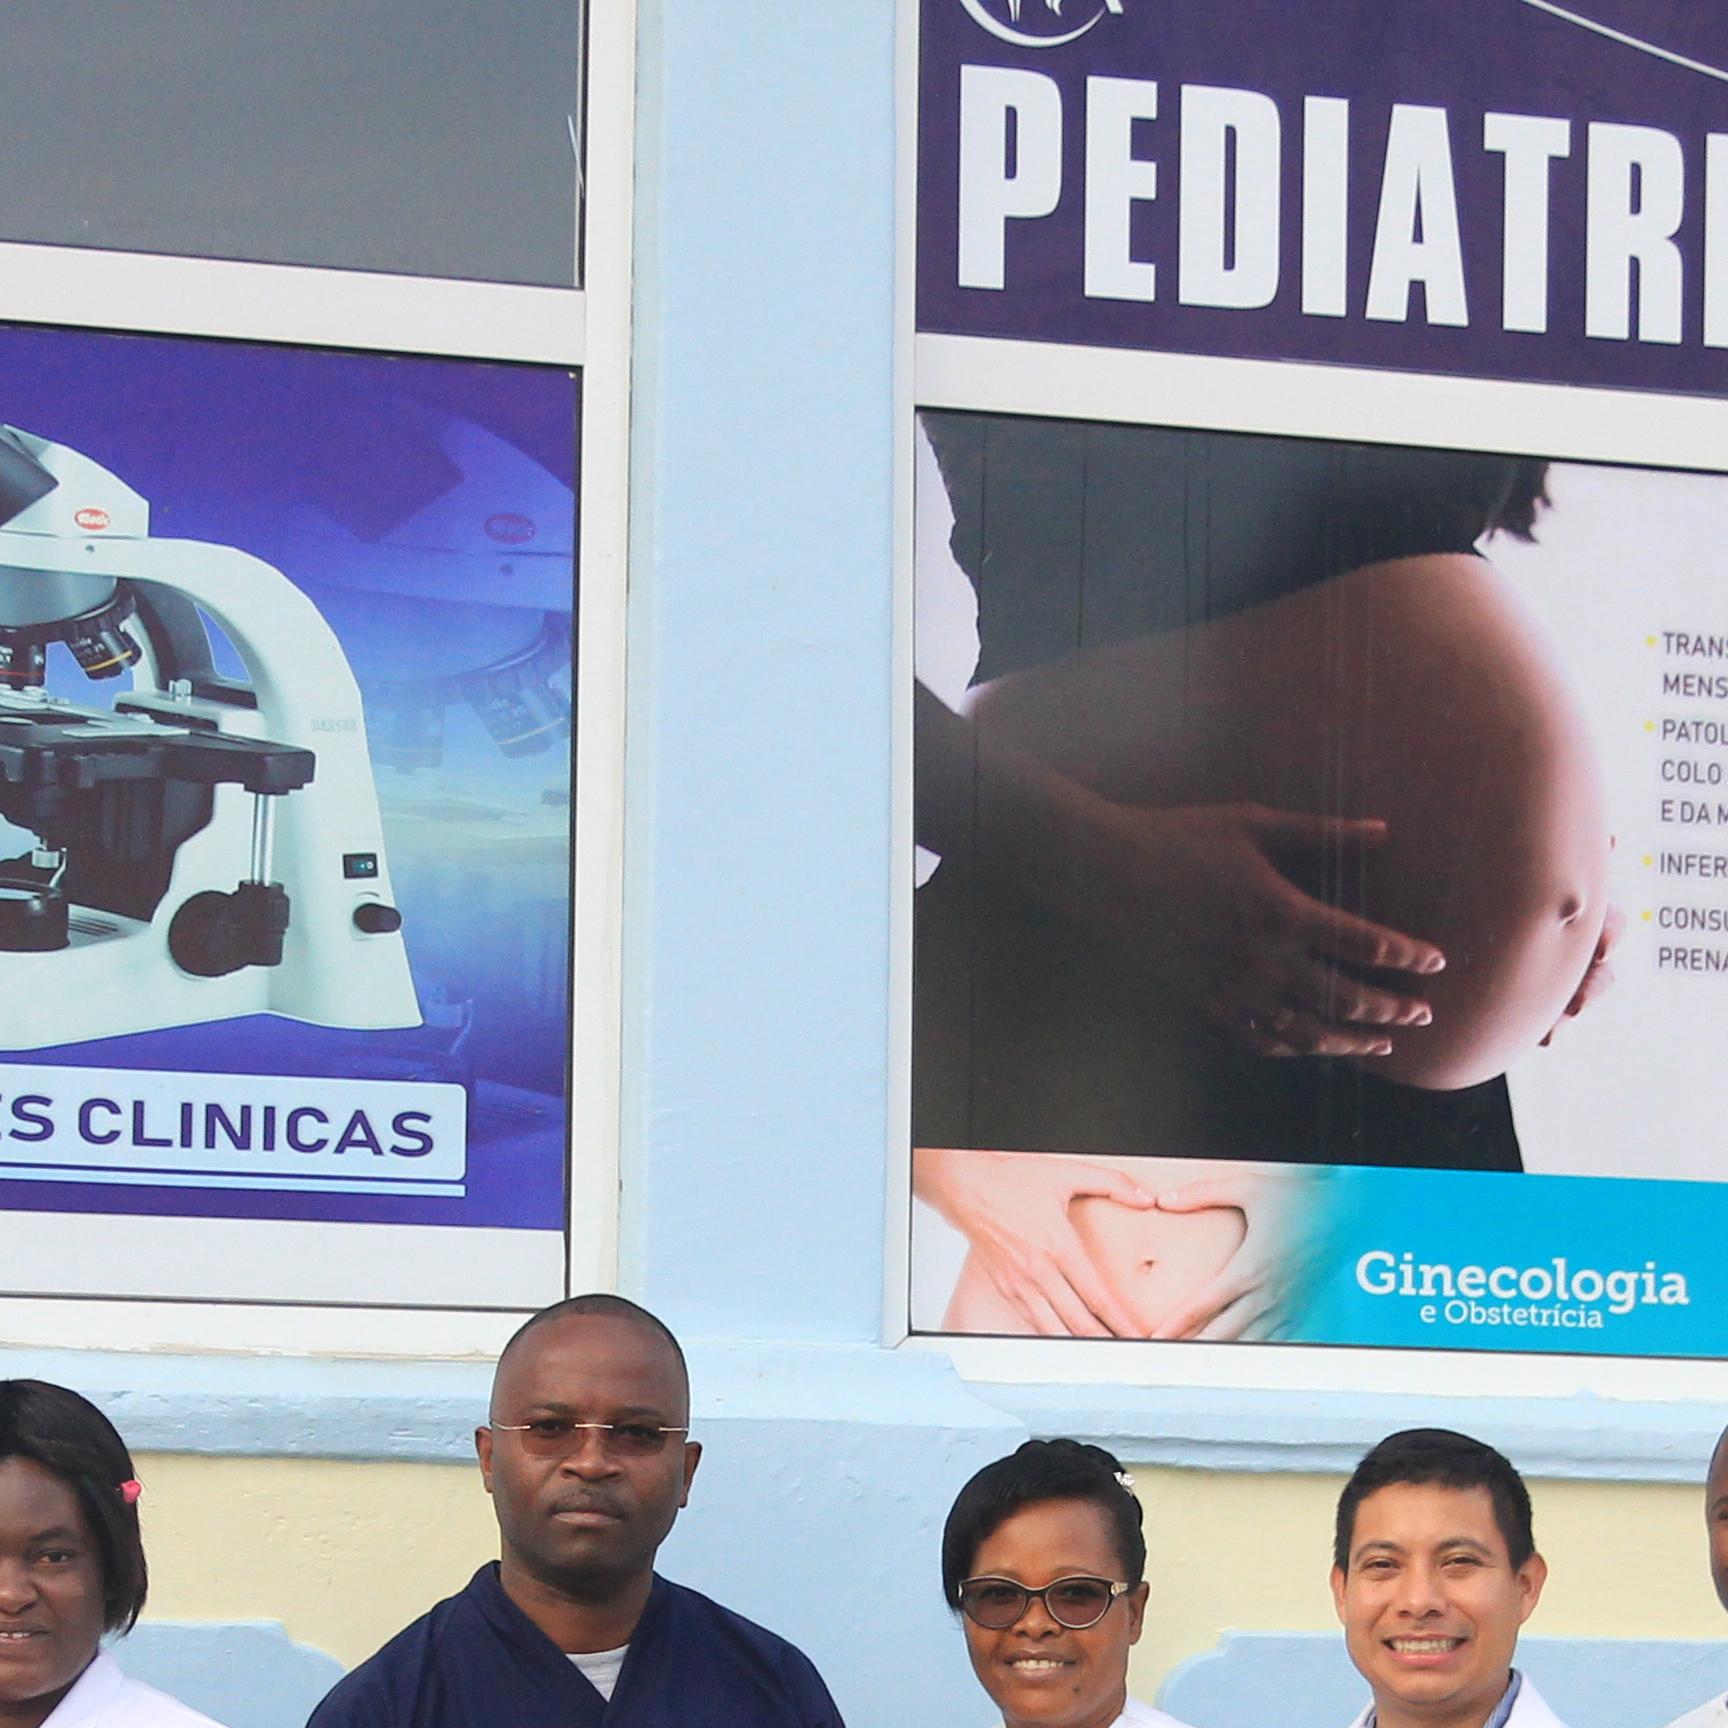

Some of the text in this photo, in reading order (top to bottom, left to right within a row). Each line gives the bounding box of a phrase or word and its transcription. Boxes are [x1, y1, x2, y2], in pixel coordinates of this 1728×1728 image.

[1660, 758, 1723, 786] COLO
[1660, 800, 1674, 822] E
[1679, 801, 1711, 824] DA
[78, 1097, 435, 1158] CLINICAS
[1355, 1250, 1690, 1315] Ginecologia
[1419, 1299, 1604, 1330] e Obstetrícia
